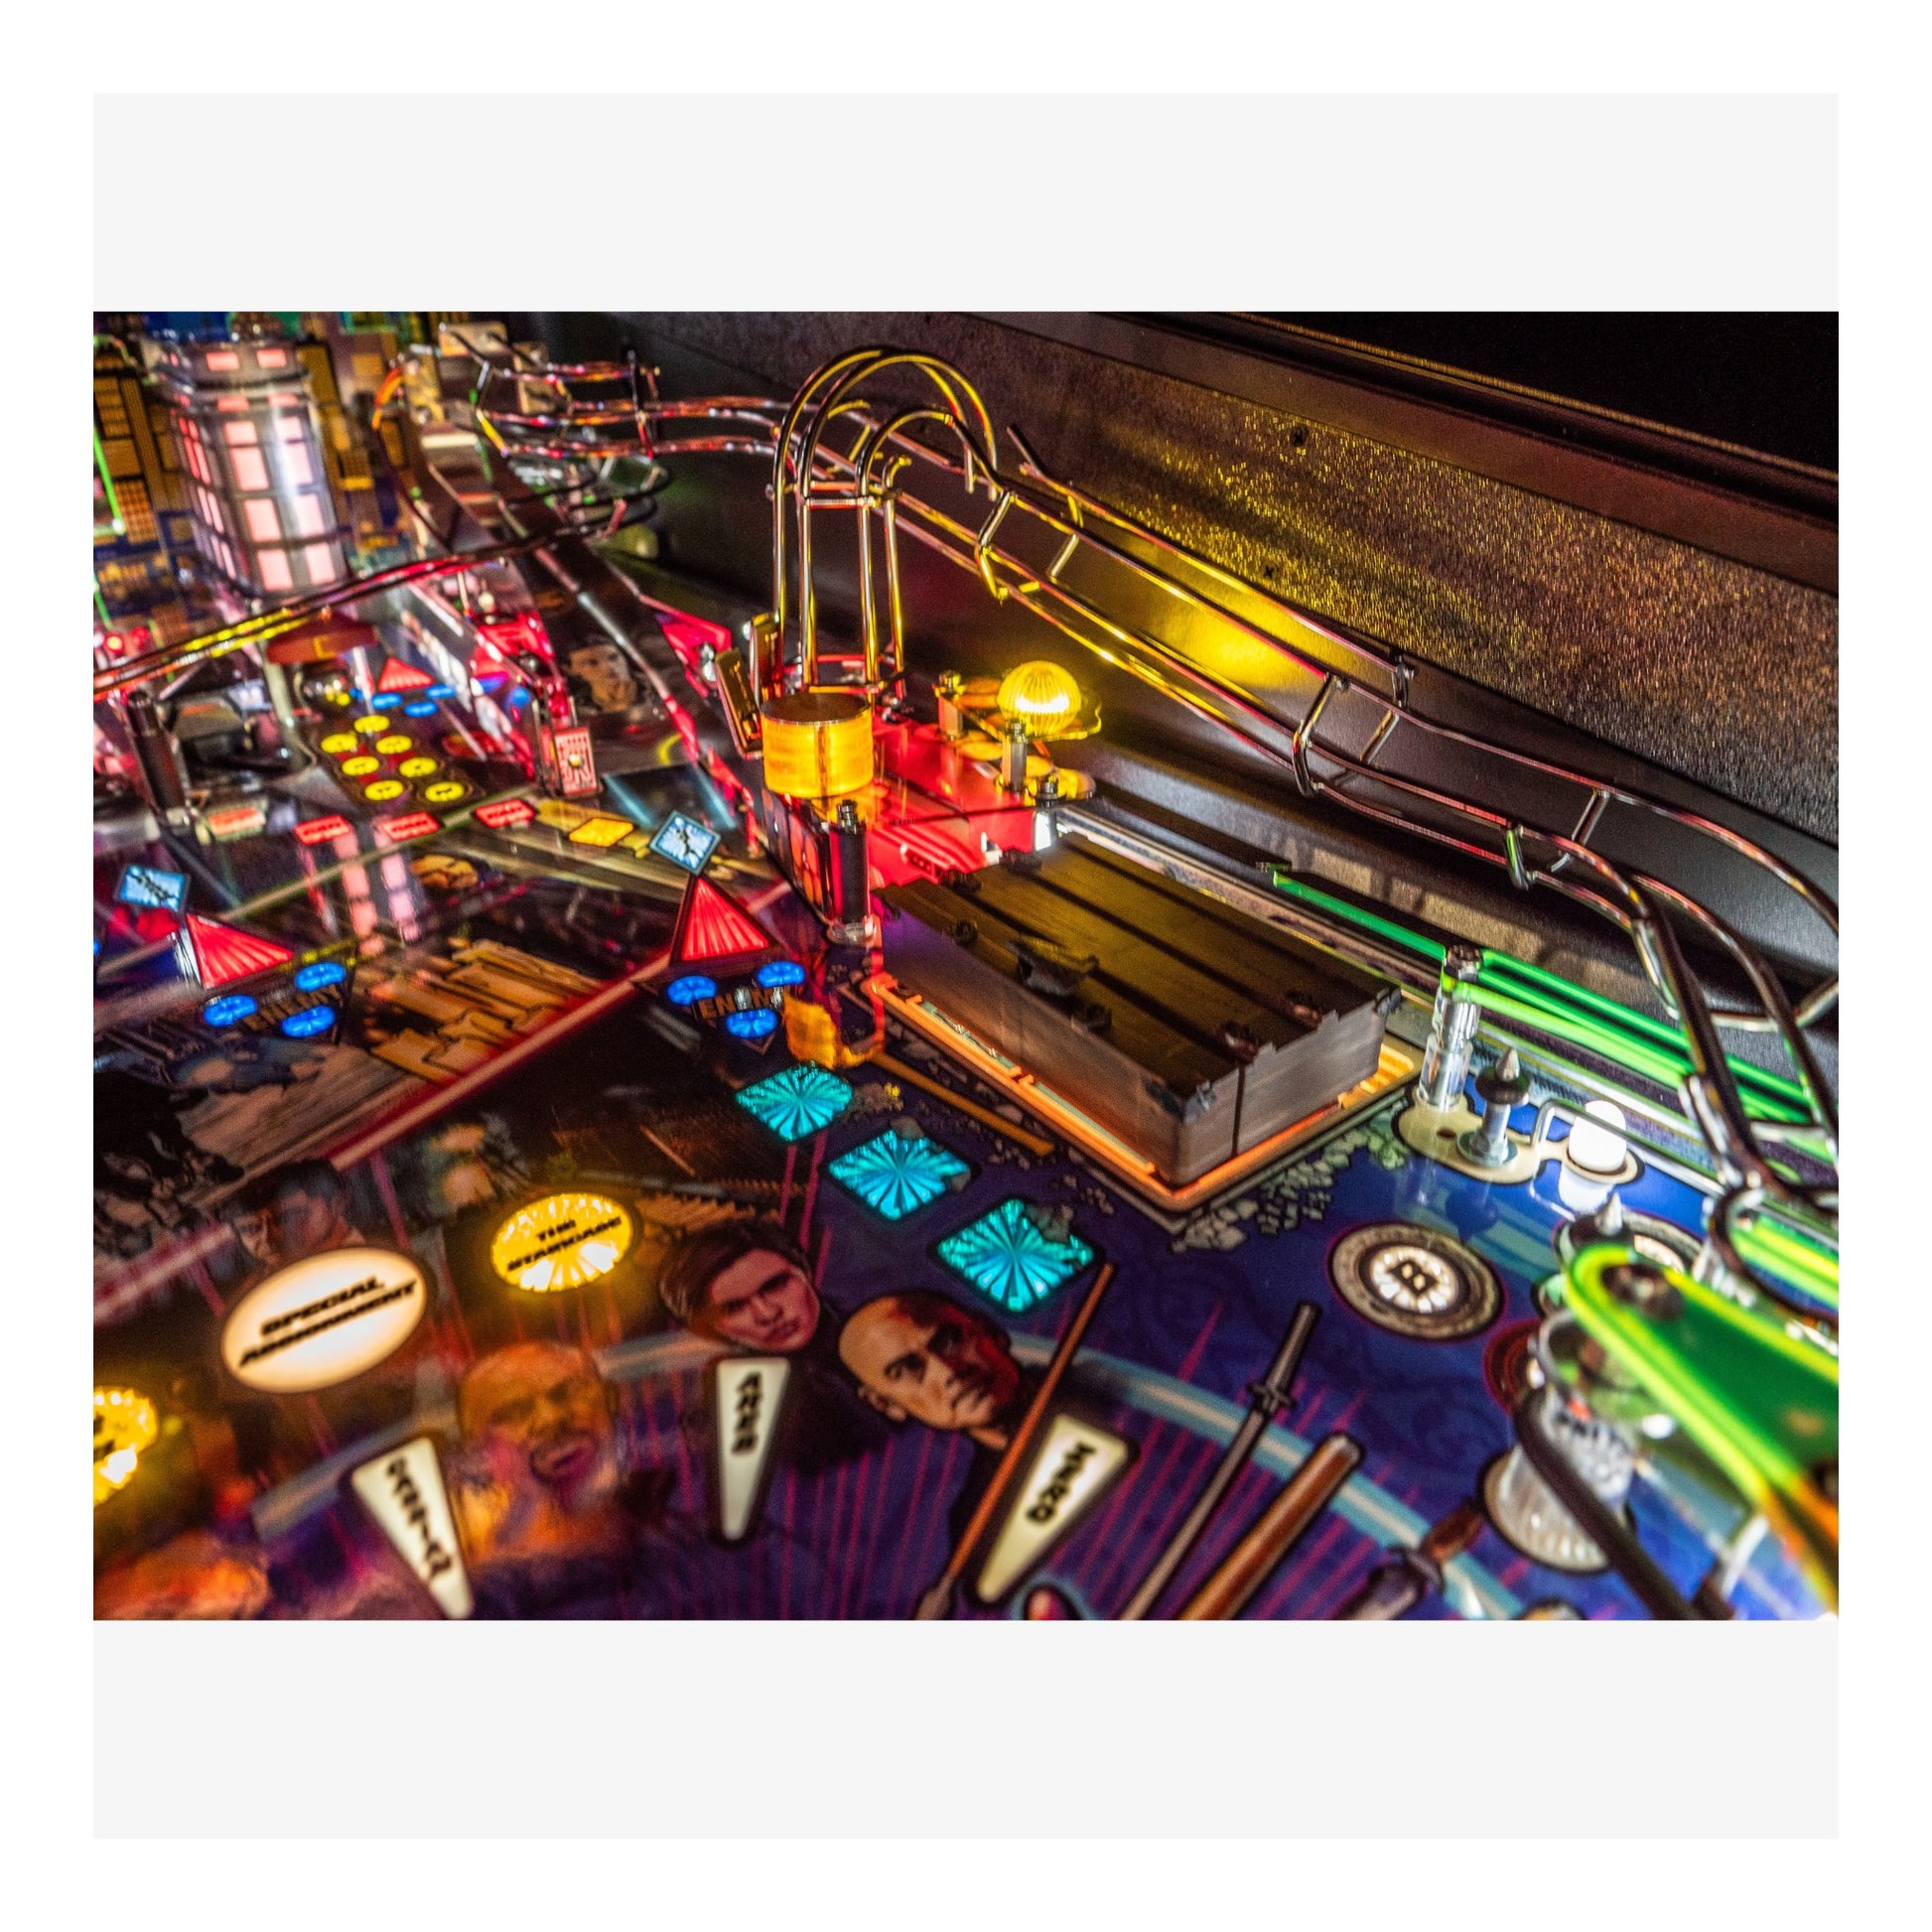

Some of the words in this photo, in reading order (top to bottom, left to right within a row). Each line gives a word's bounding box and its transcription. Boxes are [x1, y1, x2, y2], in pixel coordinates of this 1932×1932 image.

[237, 1278, 418, 1370] ASSIGNMENT
[259, 1277, 386, 1336] SPECIAL
[1026, 1442, 1098, 1525] ZERO
